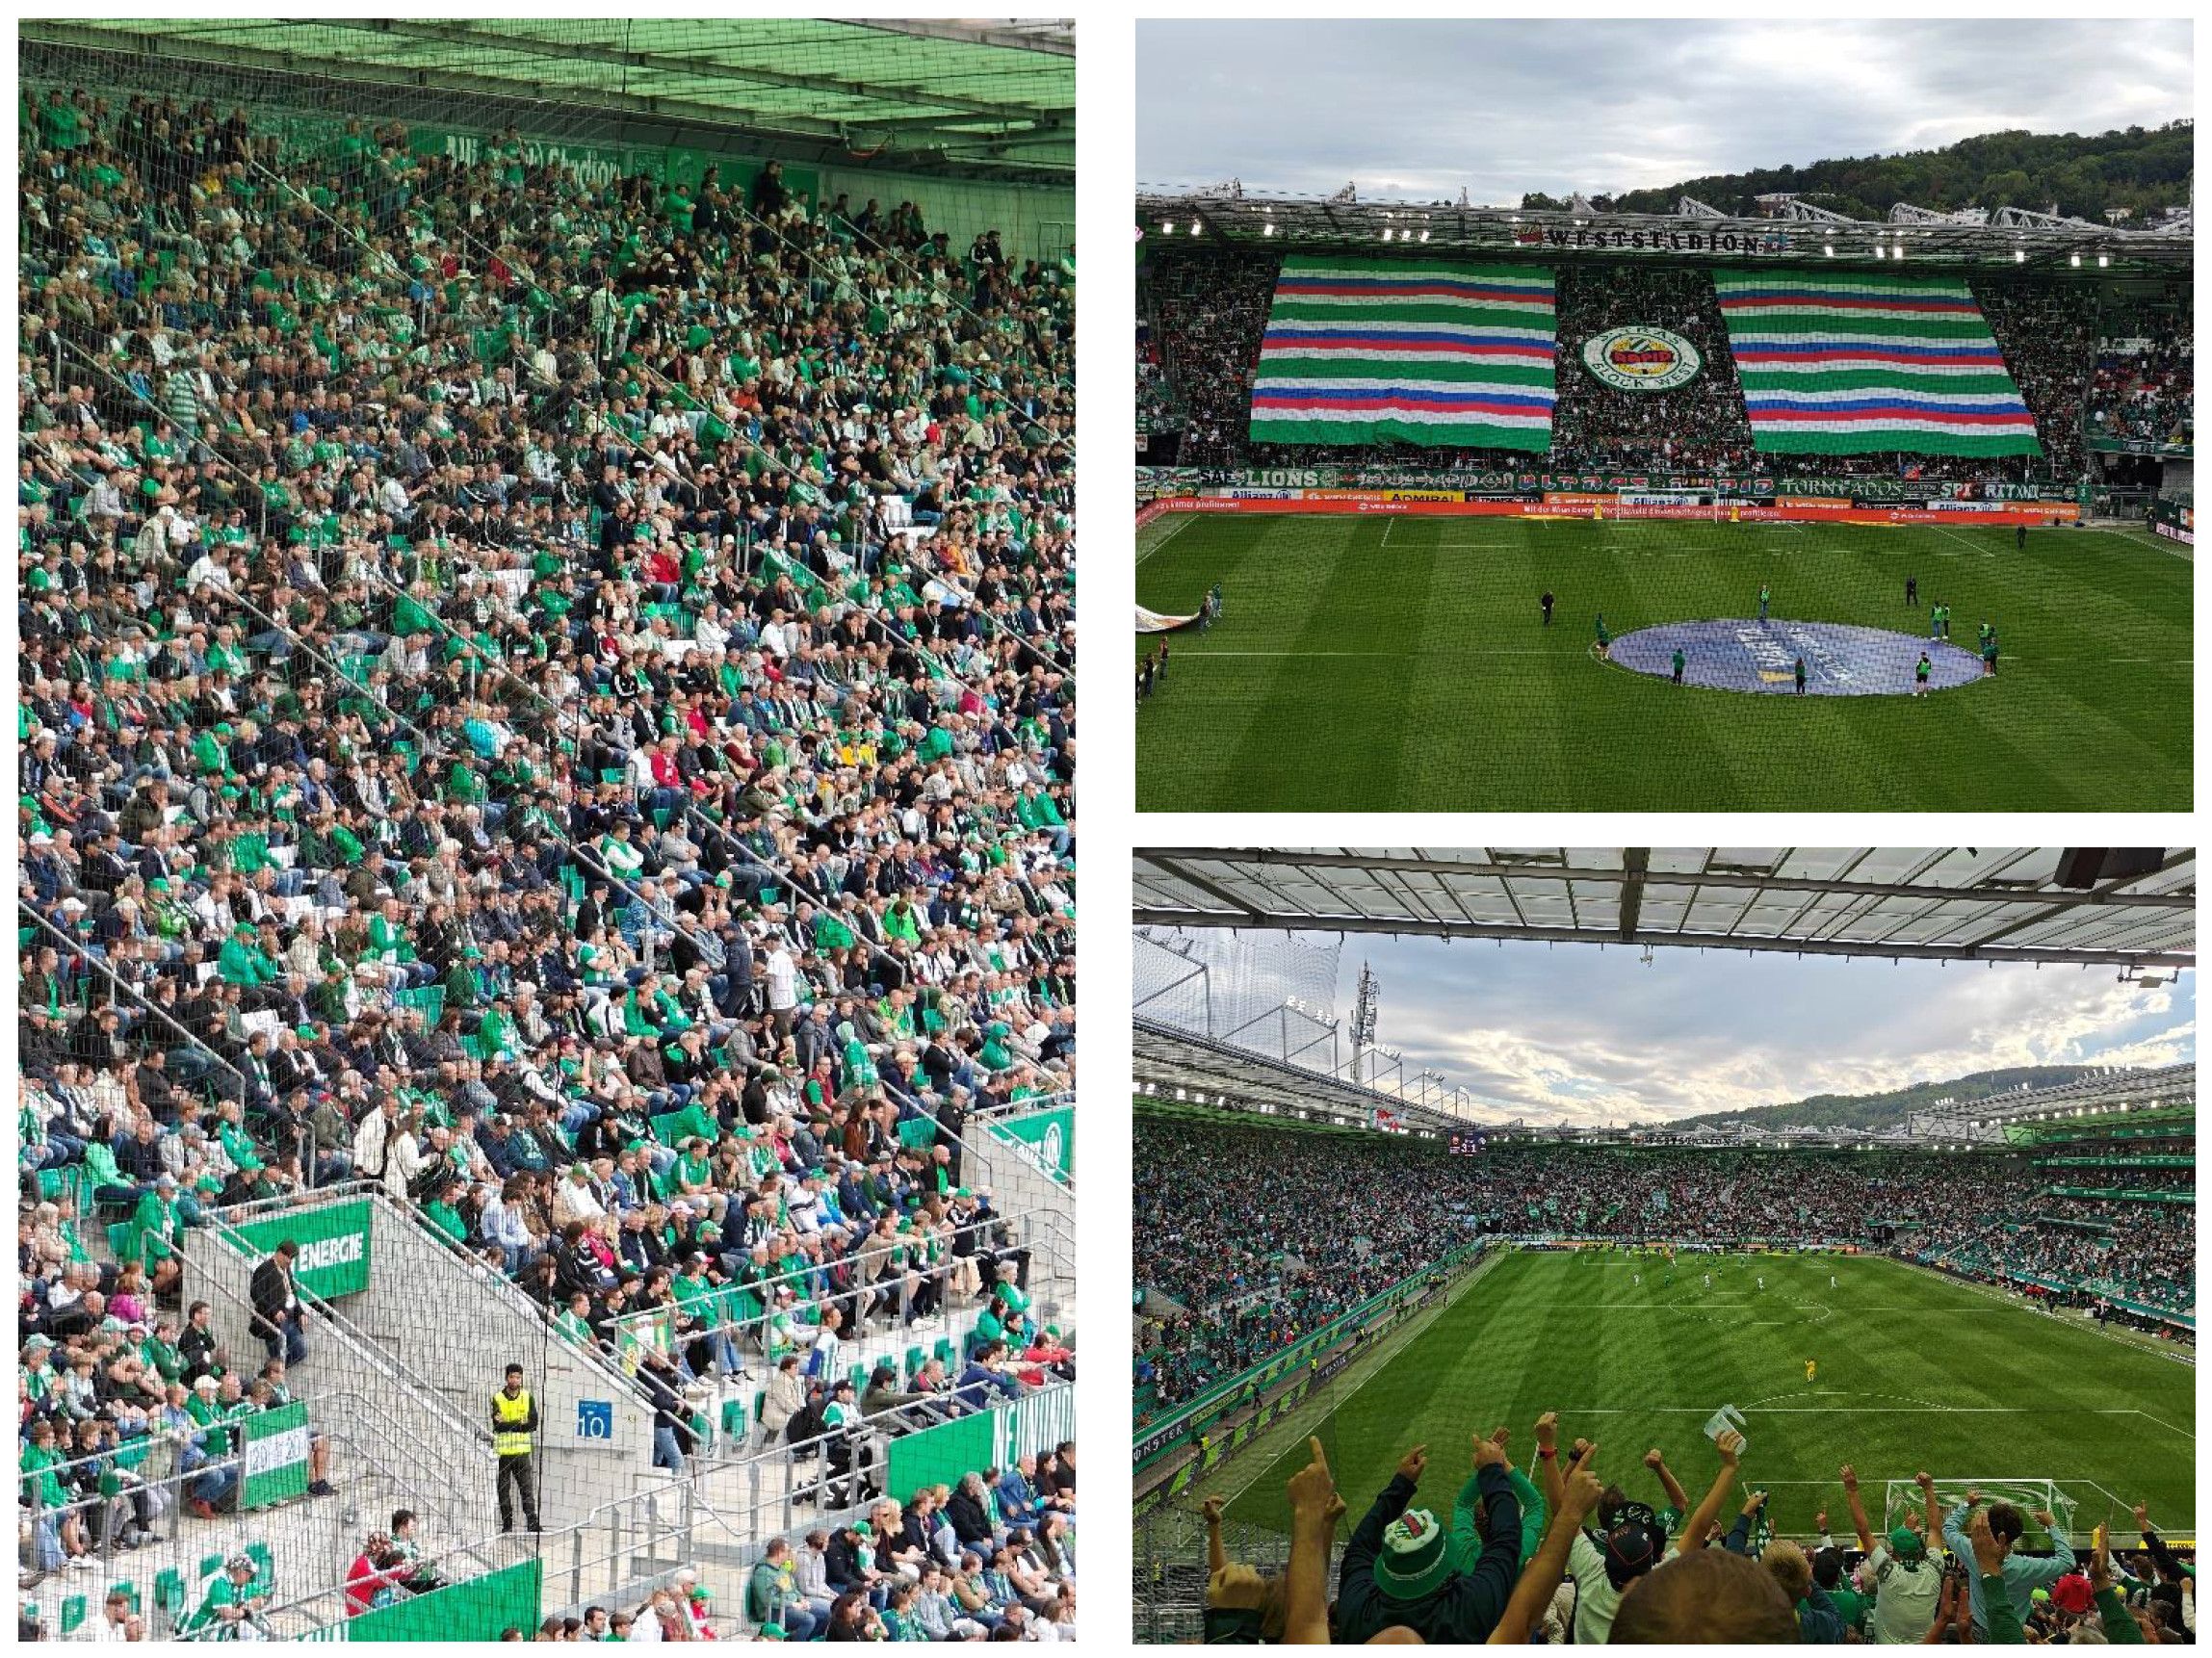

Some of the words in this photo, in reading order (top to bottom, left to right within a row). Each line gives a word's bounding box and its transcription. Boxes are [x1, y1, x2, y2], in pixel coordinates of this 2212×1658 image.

[1547, 230, 1758, 254] WESTSTADION
[1592, 362, 1645, 387] BLOCK
[1654, 362, 1696, 386] WEST
[1247, 470, 1318, 487] LIONS
[1518, 474, 1649, 492] ULTRAS
[299, 1231, 364, 1272] ENERGIE
[578, 1414, 605, 1438] 10
